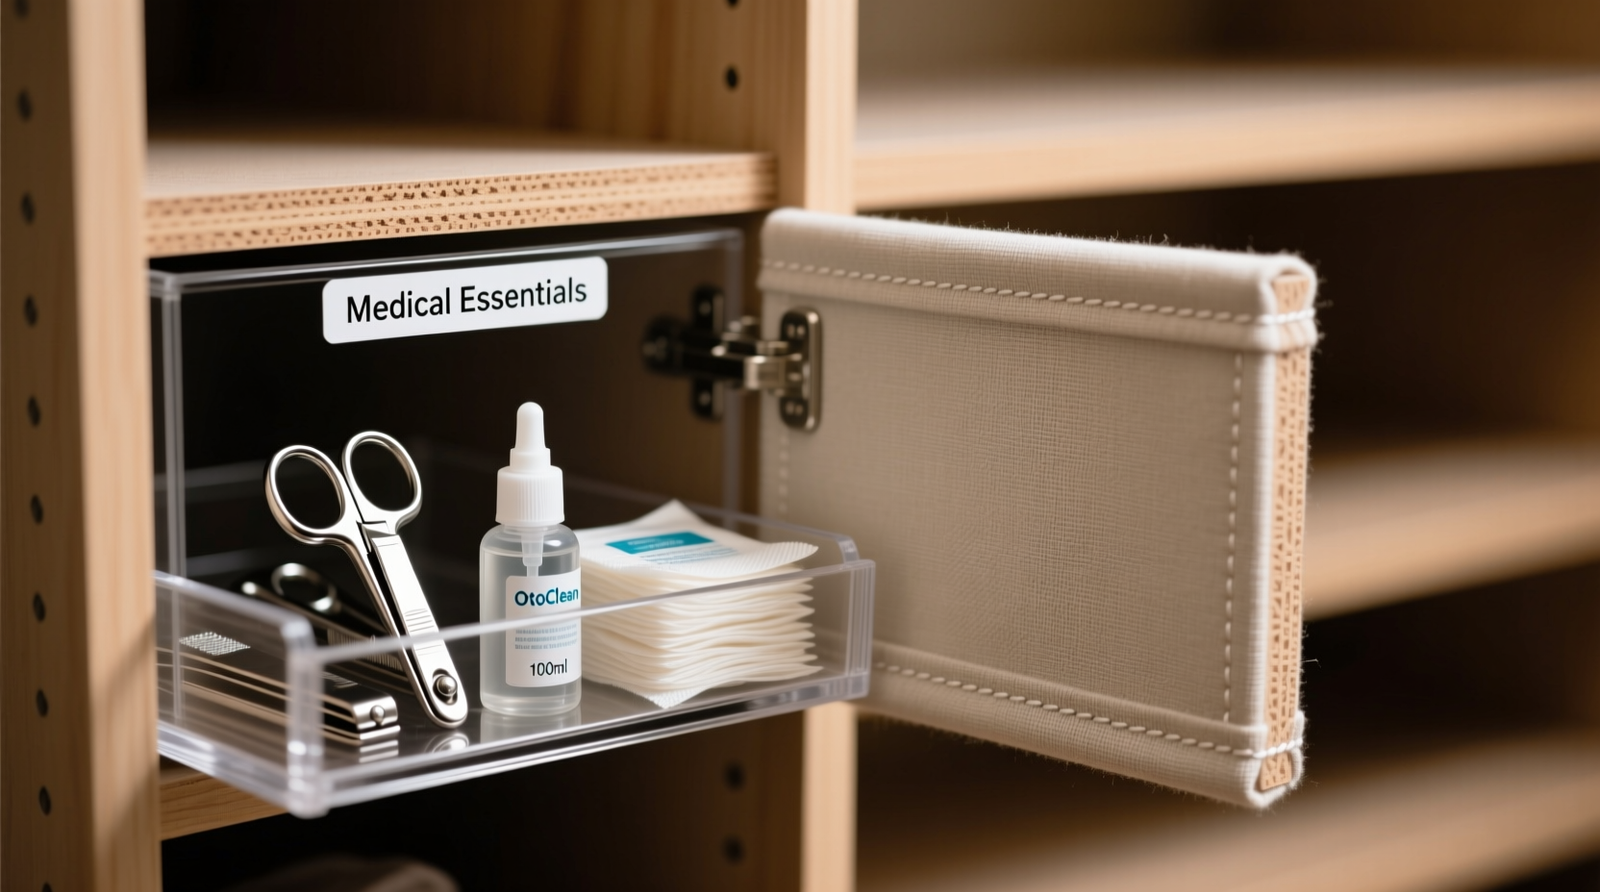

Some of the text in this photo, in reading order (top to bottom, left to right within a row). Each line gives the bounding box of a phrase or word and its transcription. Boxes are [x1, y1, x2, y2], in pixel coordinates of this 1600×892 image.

[347, 277, 587, 324] Medical Essentials
[514, 587, 579, 606] OtoClean
[530, 658, 568, 677] 100ml
